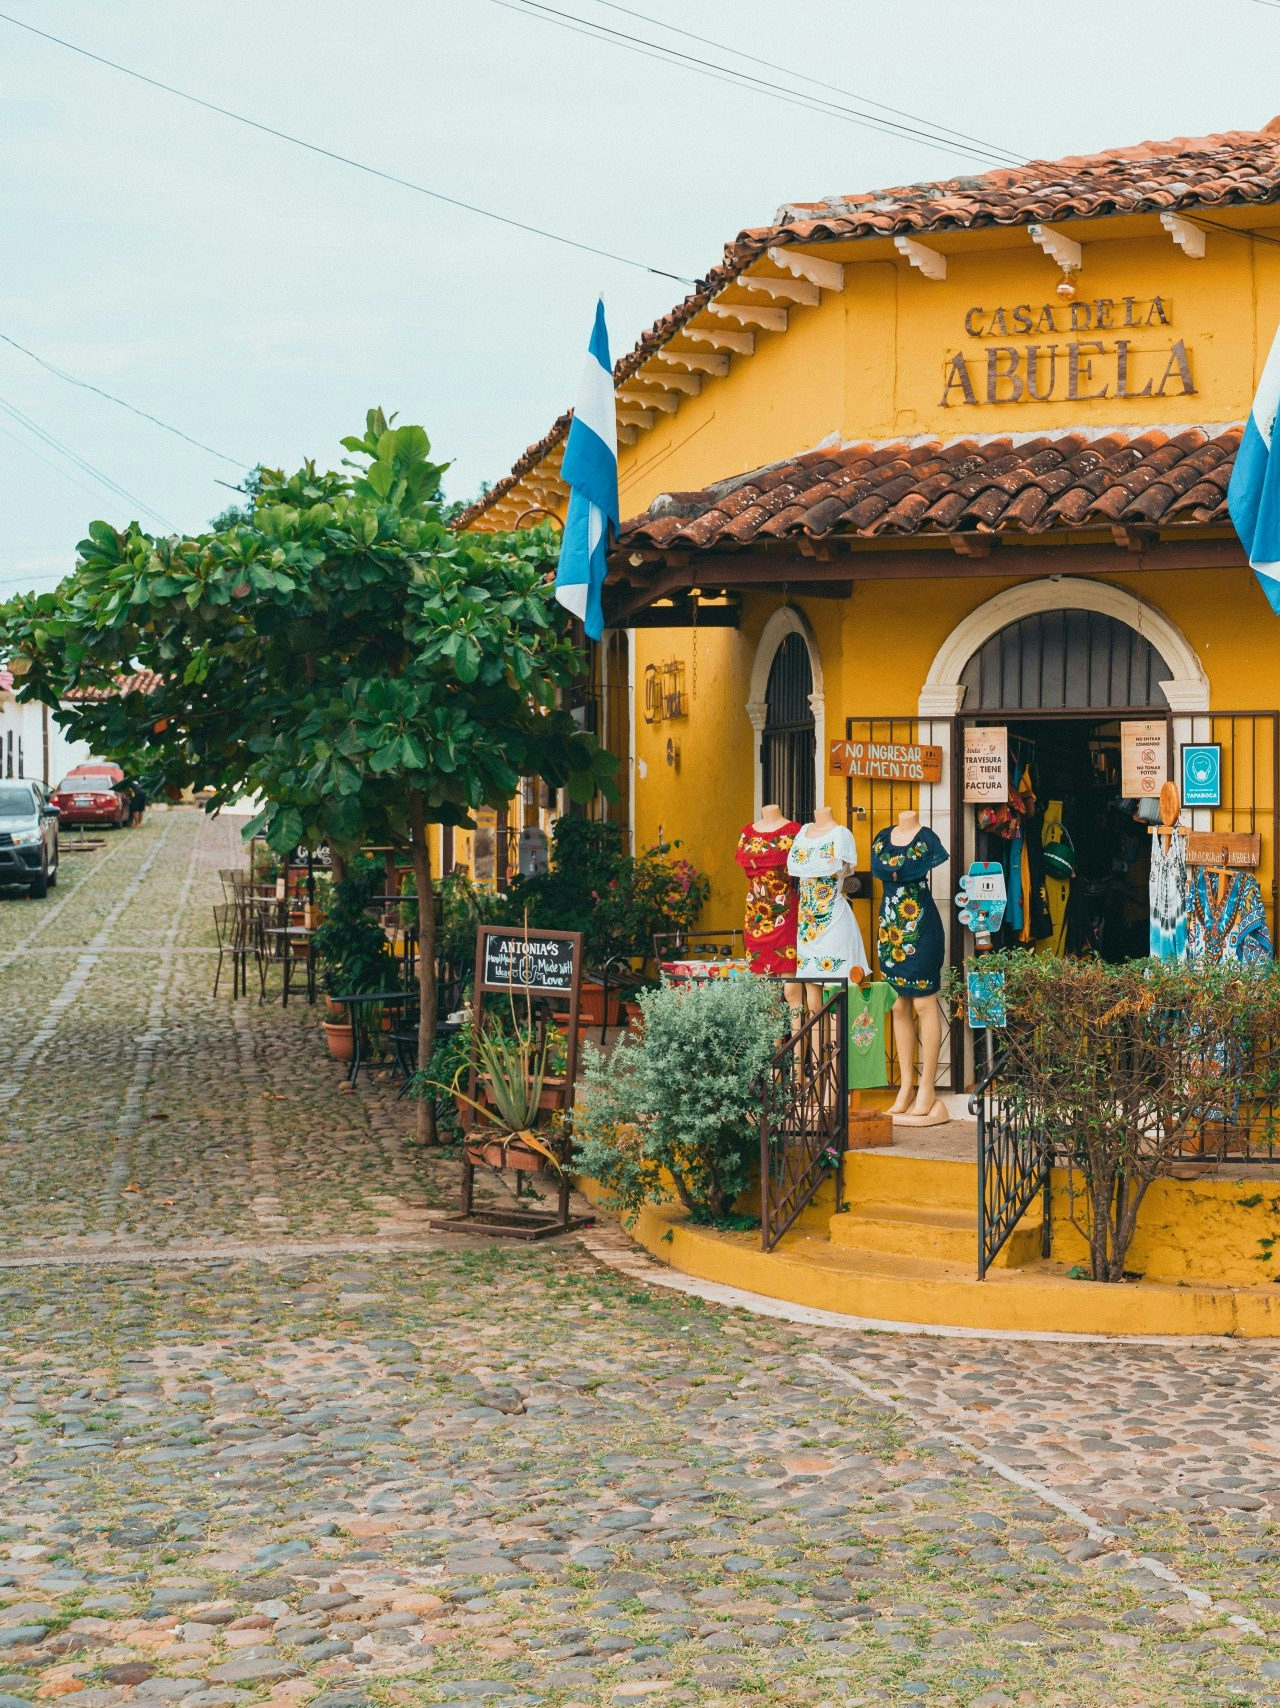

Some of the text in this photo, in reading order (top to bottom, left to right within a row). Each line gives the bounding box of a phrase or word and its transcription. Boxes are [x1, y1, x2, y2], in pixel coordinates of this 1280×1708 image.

[965, 296, 1171, 336] CASA DE LA
[938, 338, 1198, 407] ABUELA
[845, 744, 921, 762] NO INGRESAR
[849, 760, 924, 779] ALIMENTOS
[542, 975, 564, 985] Love
